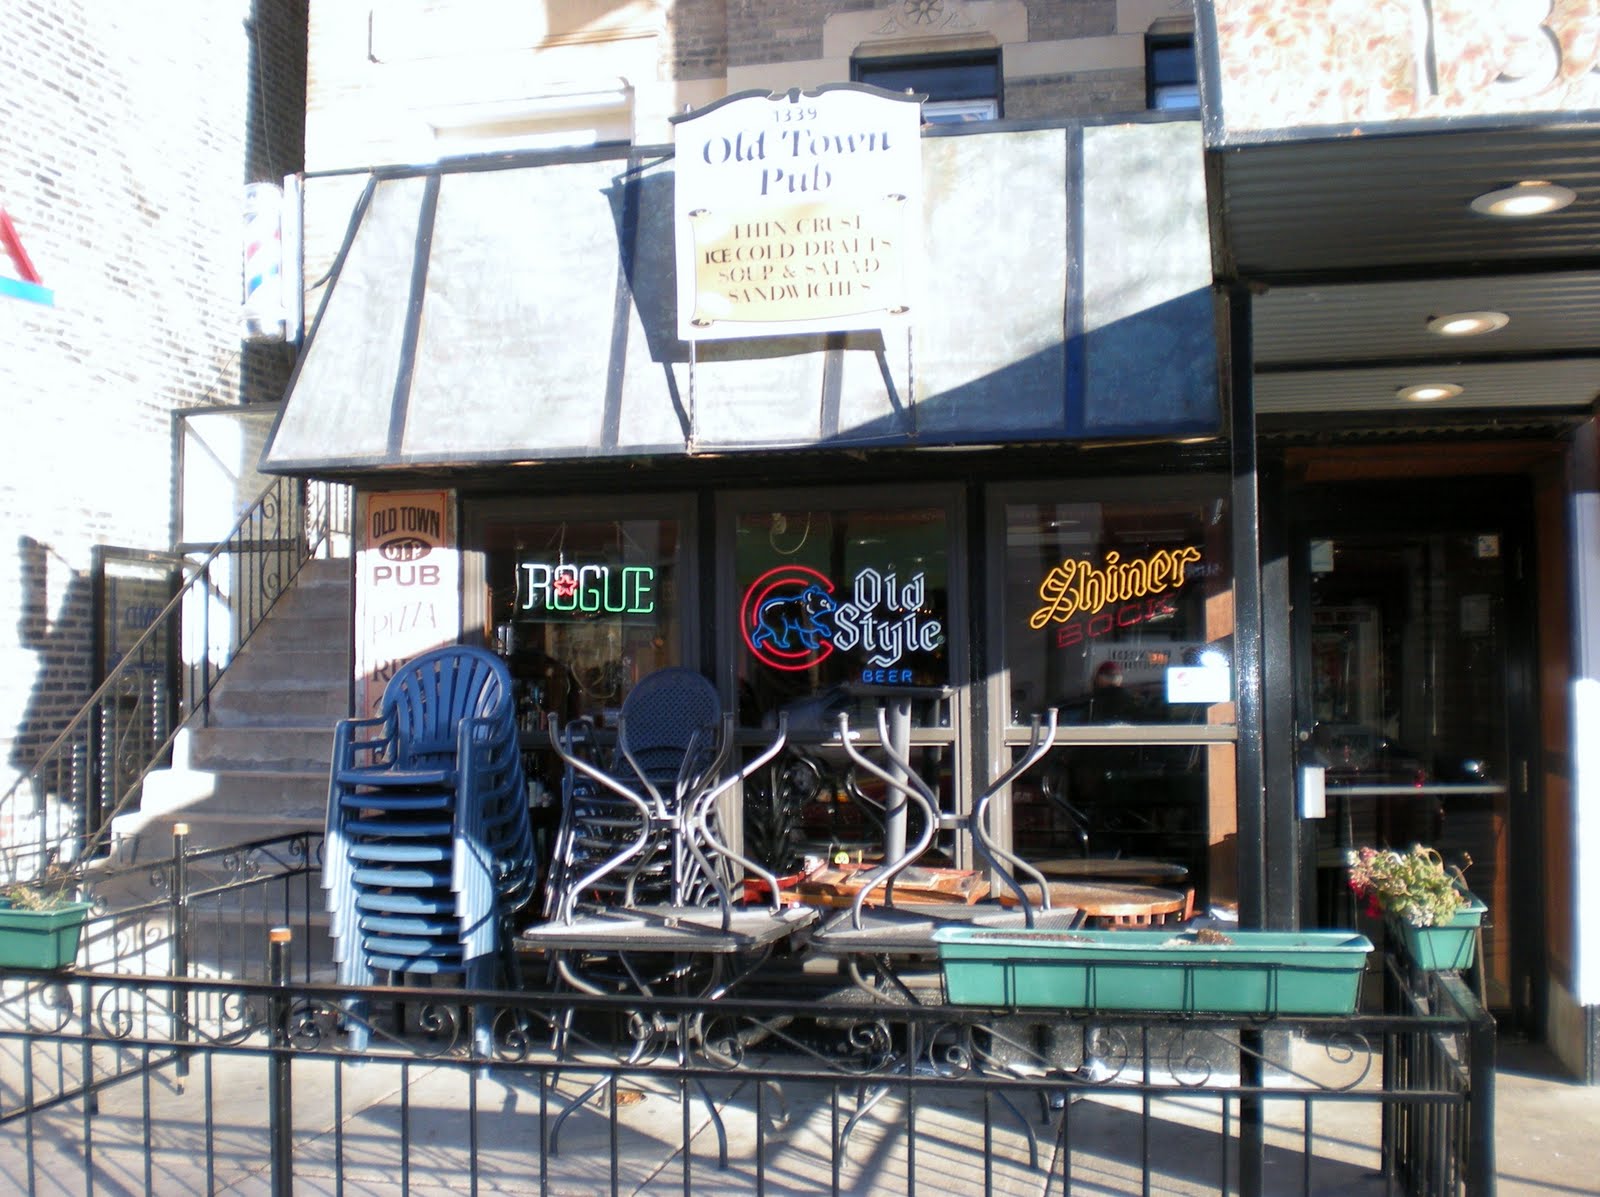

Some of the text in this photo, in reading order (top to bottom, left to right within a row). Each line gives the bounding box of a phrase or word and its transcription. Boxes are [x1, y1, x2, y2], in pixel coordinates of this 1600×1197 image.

[774, 106, 818, 123] 1339
[702, 129, 892, 165] Old Town
[760, 162, 832, 196] Pub
[732, 215, 864, 240] THIN CRUST
[705, 236, 893, 265] ICE COLD DRAFTS
[718, 258, 880, 283] SOUP & SALAD
[728, 280, 871, 303] SANDWICHES
[372, 506, 441, 539] OLD TOWN
[373, 564, 441, 587] PUB
[521, 563, 654, 613] ROGUE
[855, 568, 925, 612] Old
[1030, 546, 1201, 629] Shiner
[833, 603, 942, 668] Style
[1056, 593, 1177, 649] BOCK
[862, 670, 913, 683] BEER
